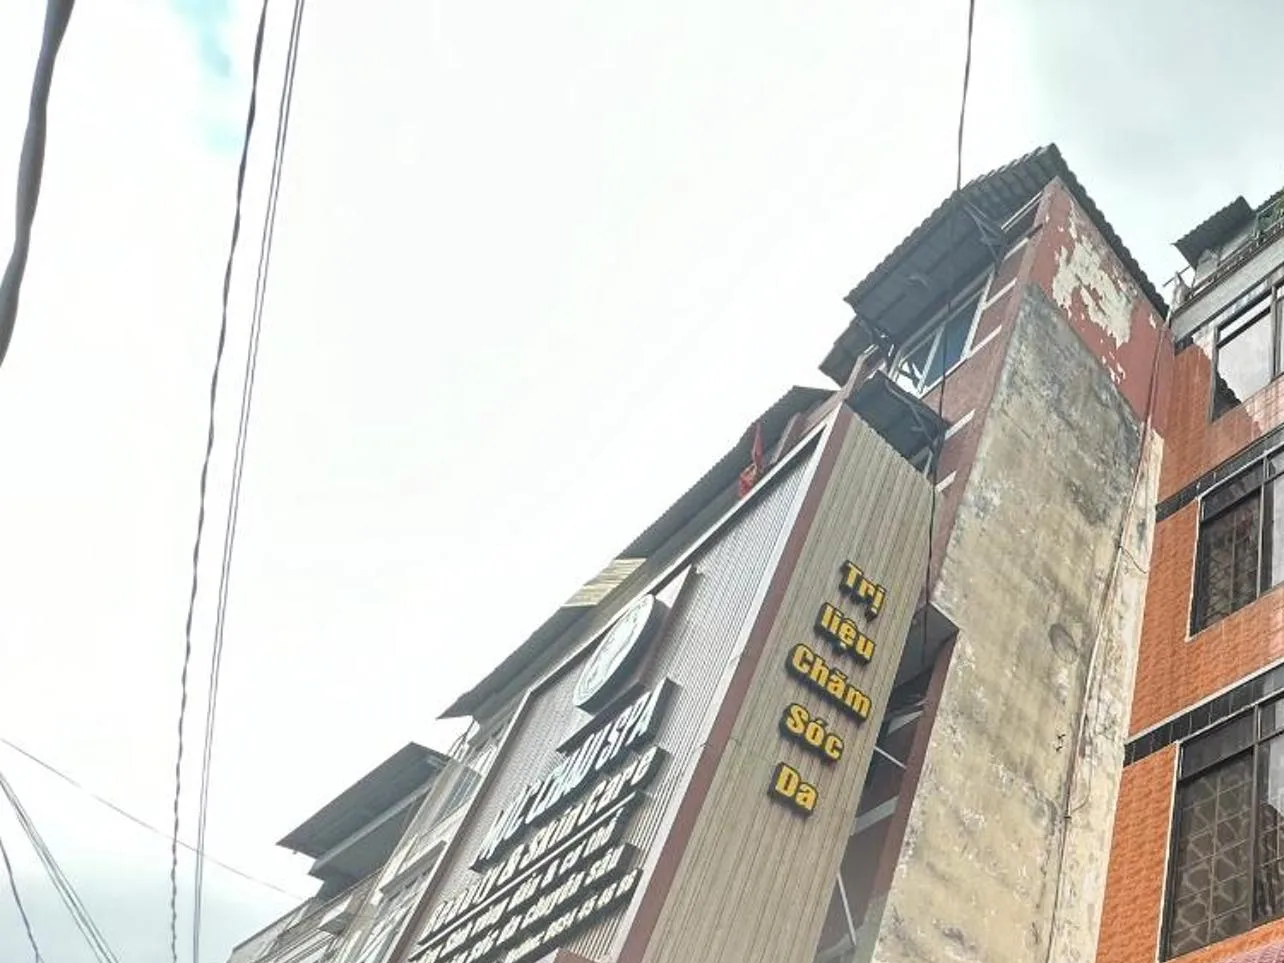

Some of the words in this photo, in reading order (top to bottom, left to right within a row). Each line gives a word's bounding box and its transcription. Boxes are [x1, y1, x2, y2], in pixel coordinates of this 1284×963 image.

[845, 561, 888, 616] Trị
[819, 602, 876, 662] liệu
[790, 642, 872, 721] Chăm
[784, 703, 845, 762] Sóc
